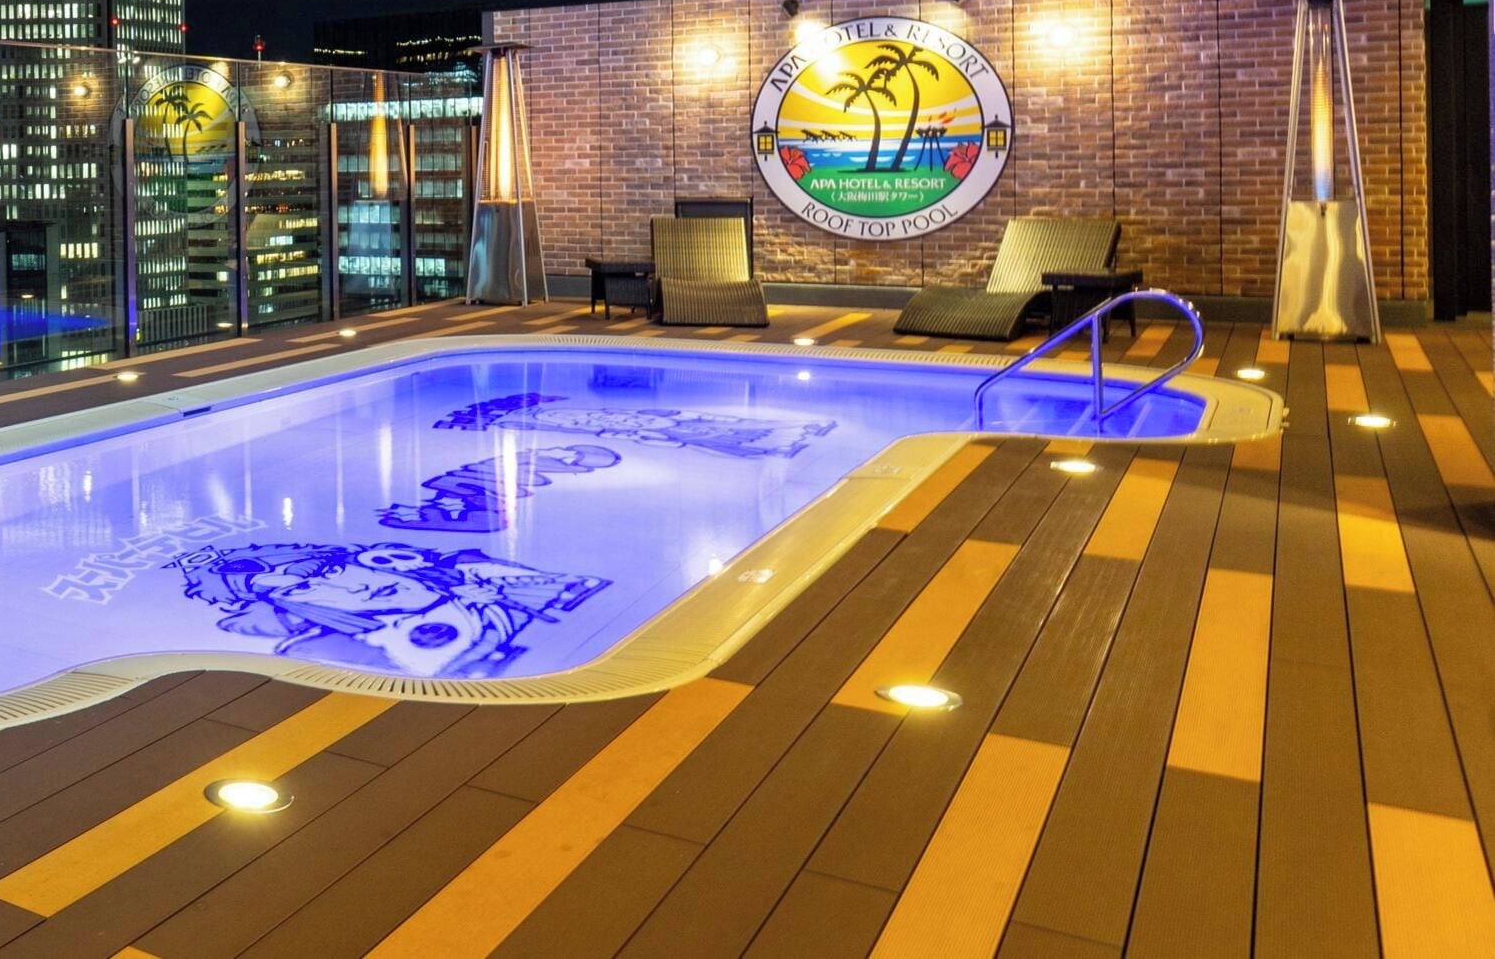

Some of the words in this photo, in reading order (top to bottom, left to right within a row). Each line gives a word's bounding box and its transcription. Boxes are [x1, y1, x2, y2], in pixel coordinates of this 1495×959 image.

[770, 54, 808, 92] APA
[822, 21, 882, 47] OTEL
[884, 23, 899, 38] &
[810, 177, 837, 190] APA
[839, 177, 879, 190] HOTEL
[882, 180, 892, 190] &
[894, 177, 946, 190] RESORT
[801, 201, 854, 234] ROOF
[858, 219, 896, 238] TOP
[902, 203, 959, 235] POOL
